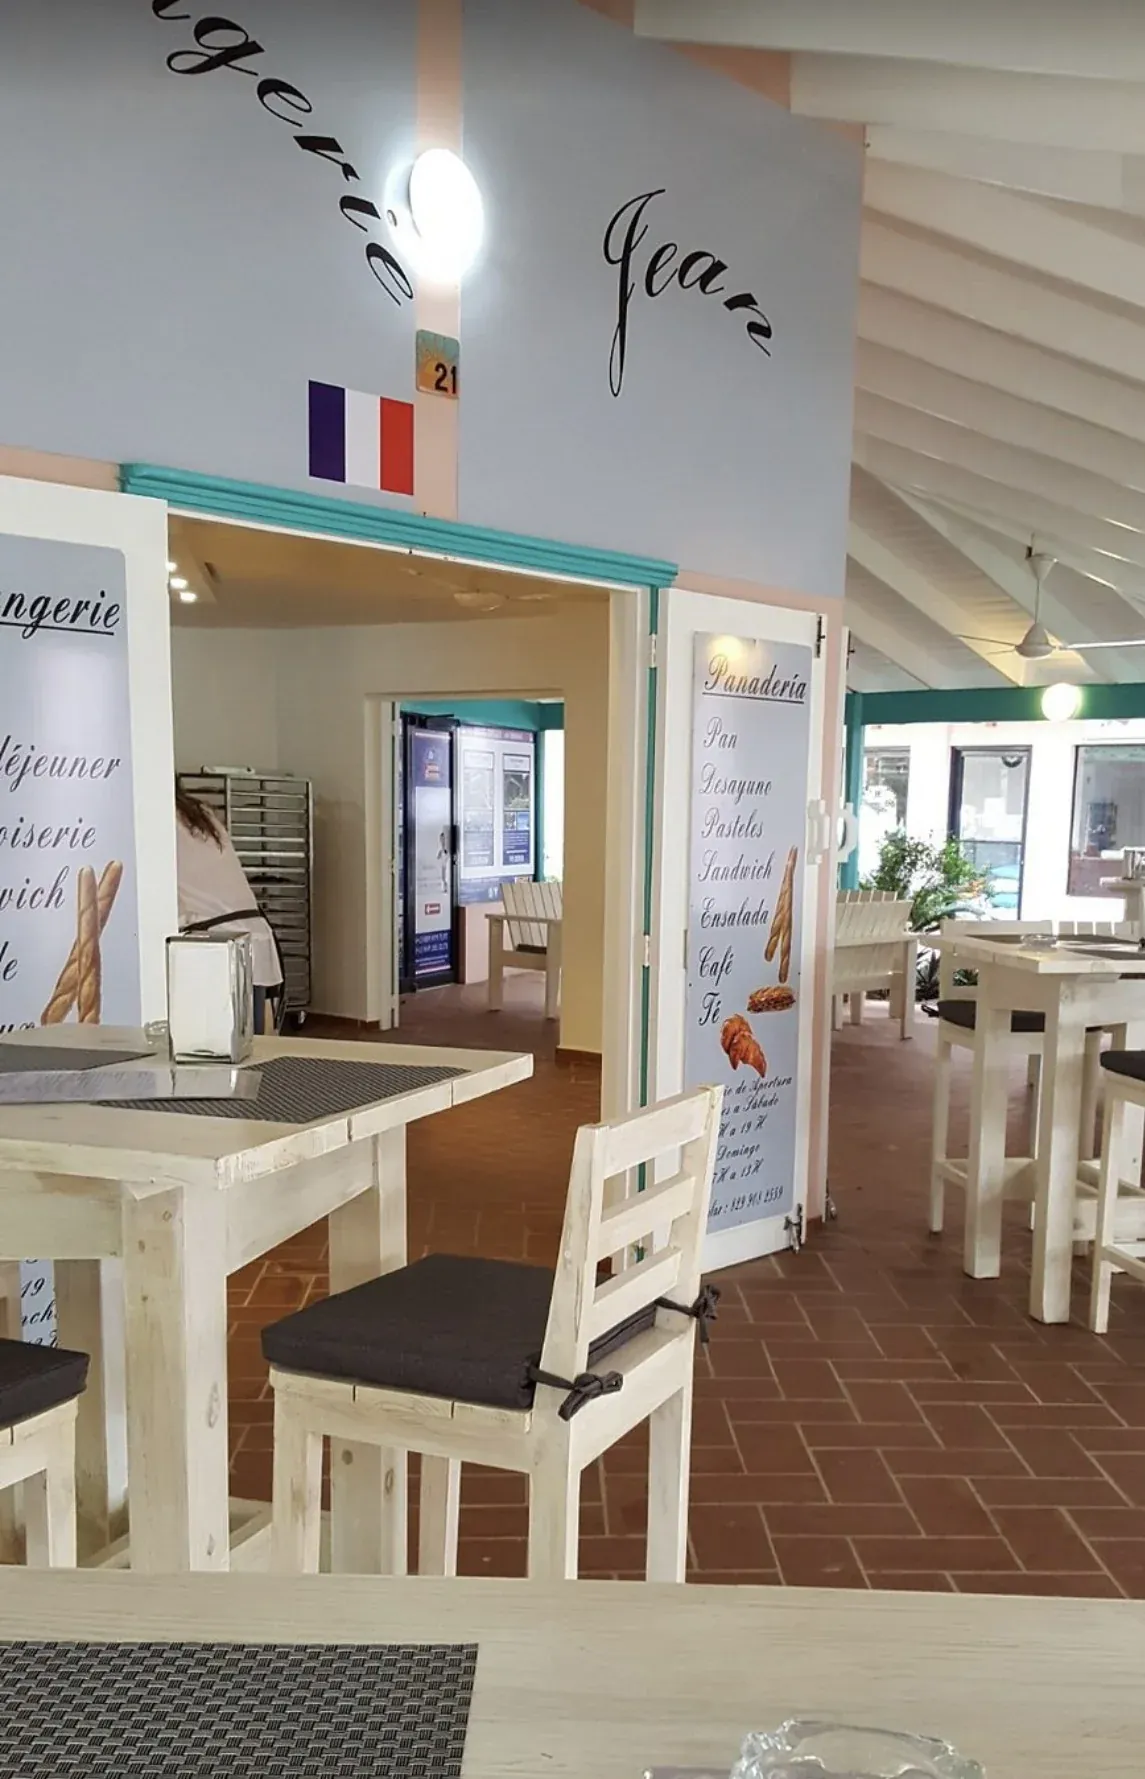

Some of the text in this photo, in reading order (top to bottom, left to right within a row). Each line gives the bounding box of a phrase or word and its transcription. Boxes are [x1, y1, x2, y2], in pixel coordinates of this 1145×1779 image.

[604, 188, 772, 397] Jean
[434, 362, 457, 395] 21
[0, 590, 120, 639] ngerie
[704, 654, 807, 699] Panadería
[703, 716, 738, 749] Pan
[700, 762, 772, 804] Desayuno
[701, 807, 763, 839] Pasteles
[698, 850, 774, 882] Sandwich
[700, 897, 769, 928] Ensalada
[699, 945, 734, 987] Café
[698, 992, 722, 1027] Té
